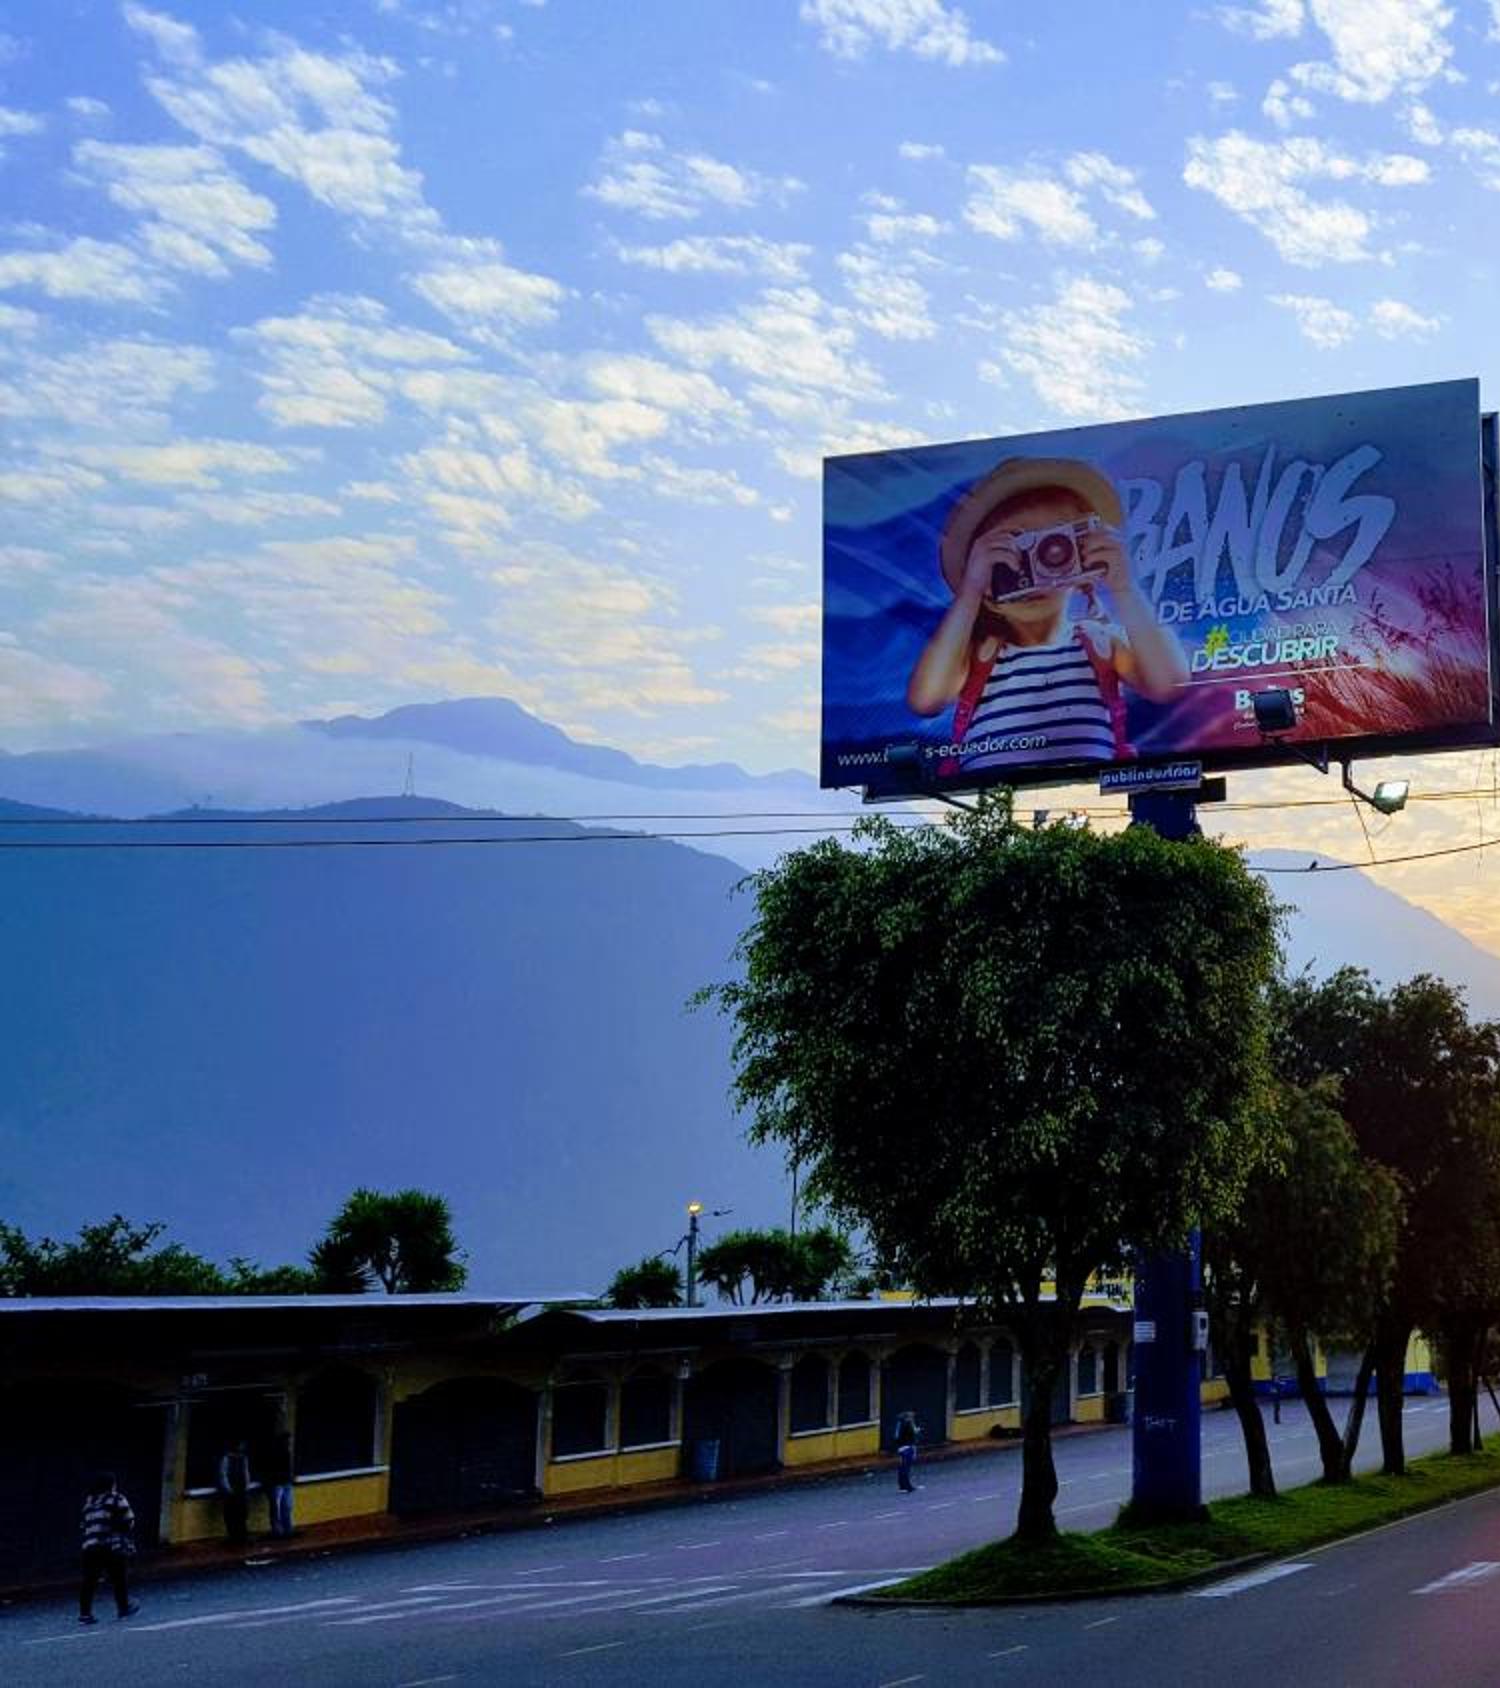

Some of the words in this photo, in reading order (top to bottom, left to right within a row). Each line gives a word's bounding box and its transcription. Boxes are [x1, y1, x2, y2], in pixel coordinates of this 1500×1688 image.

[1158, 599, 1193, 624] DE
[1197, 594, 1271, 621] AGUA
[1276, 583, 1358, 612] SANTA
[1190, 633, 1339, 673] DESCUBRIR
